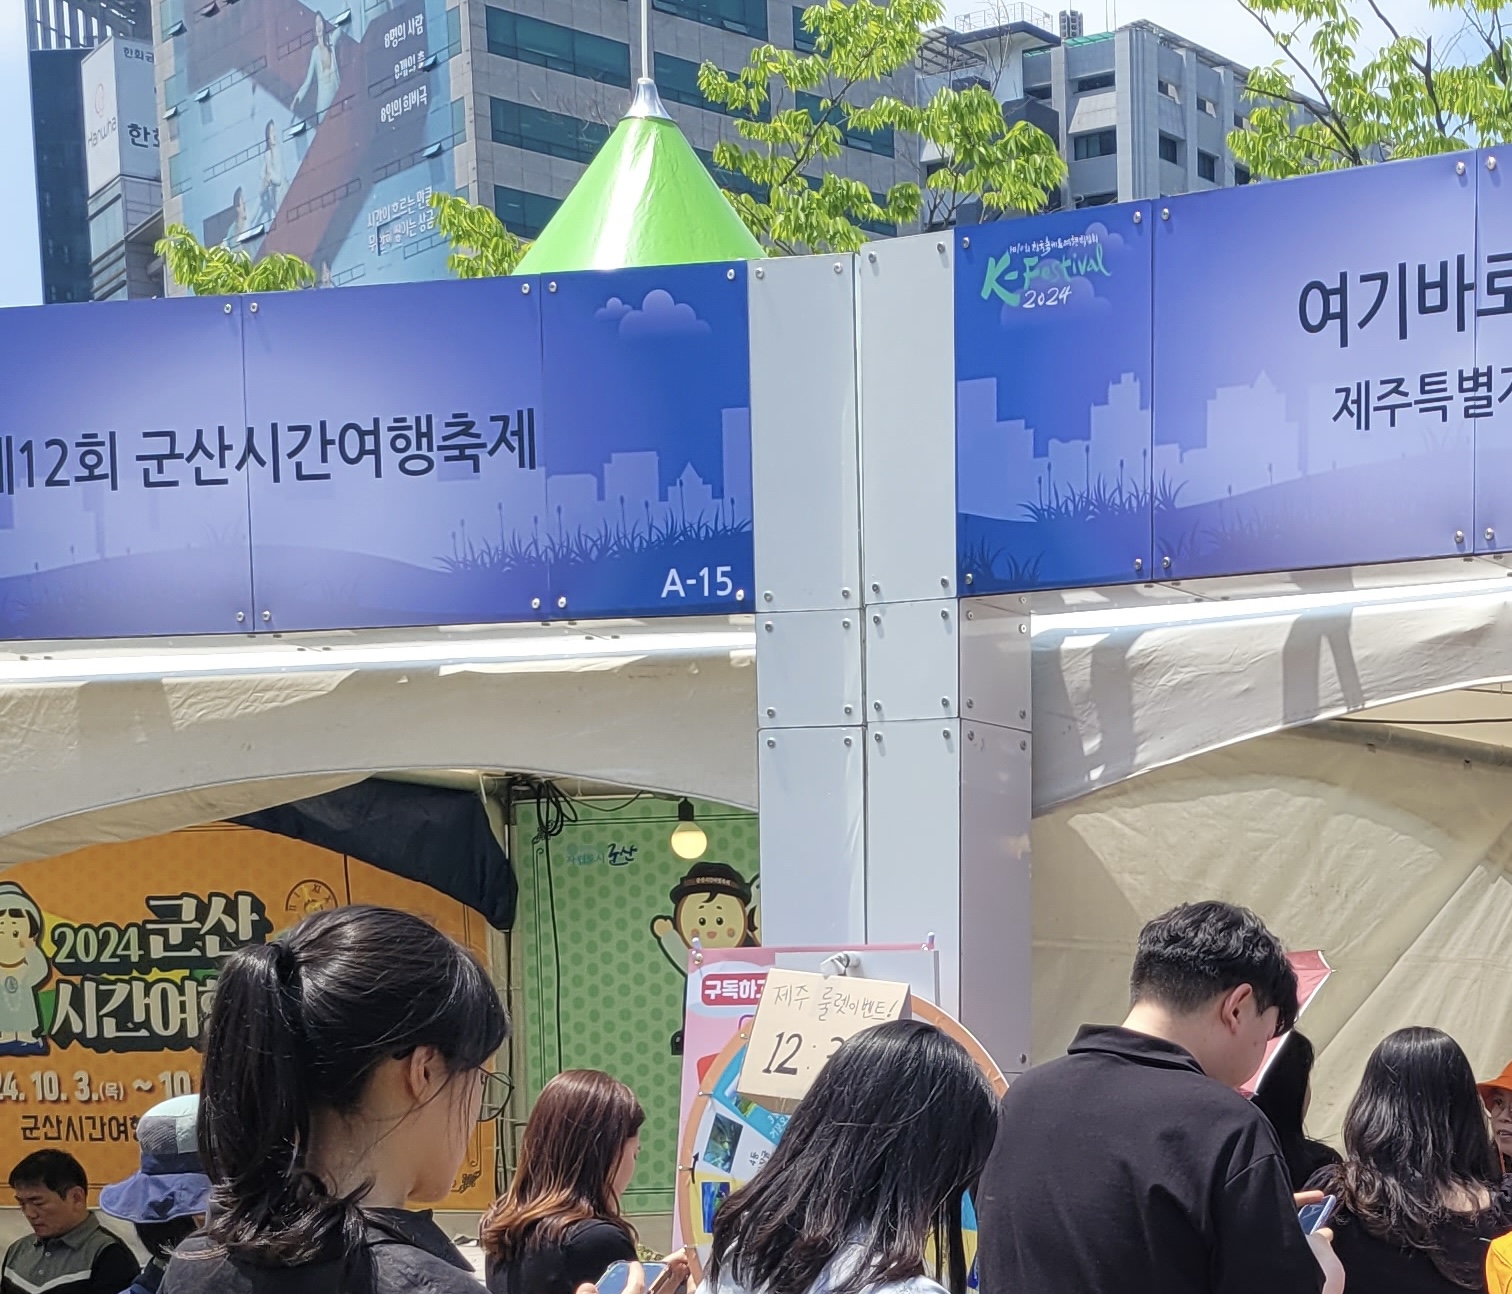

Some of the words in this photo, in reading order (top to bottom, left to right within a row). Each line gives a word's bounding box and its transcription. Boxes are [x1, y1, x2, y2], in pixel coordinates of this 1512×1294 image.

[407, 13, 424, 36] 사람
[381, 97, 402, 123] 8인의
[981, 243, 1112, 307] K-Festival
[1022, 285, 1072, 308] 2024
[135, 407, 538, 490] 군산시간여행축제
[662, 565, 734, 598] A-15
[54, 926, 145, 964] 2024
[146, 894, 260, 959] 군산
[773, 984, 811, 1011] 제주
[817, 986, 900, 1022] 룰렛이벤트!
